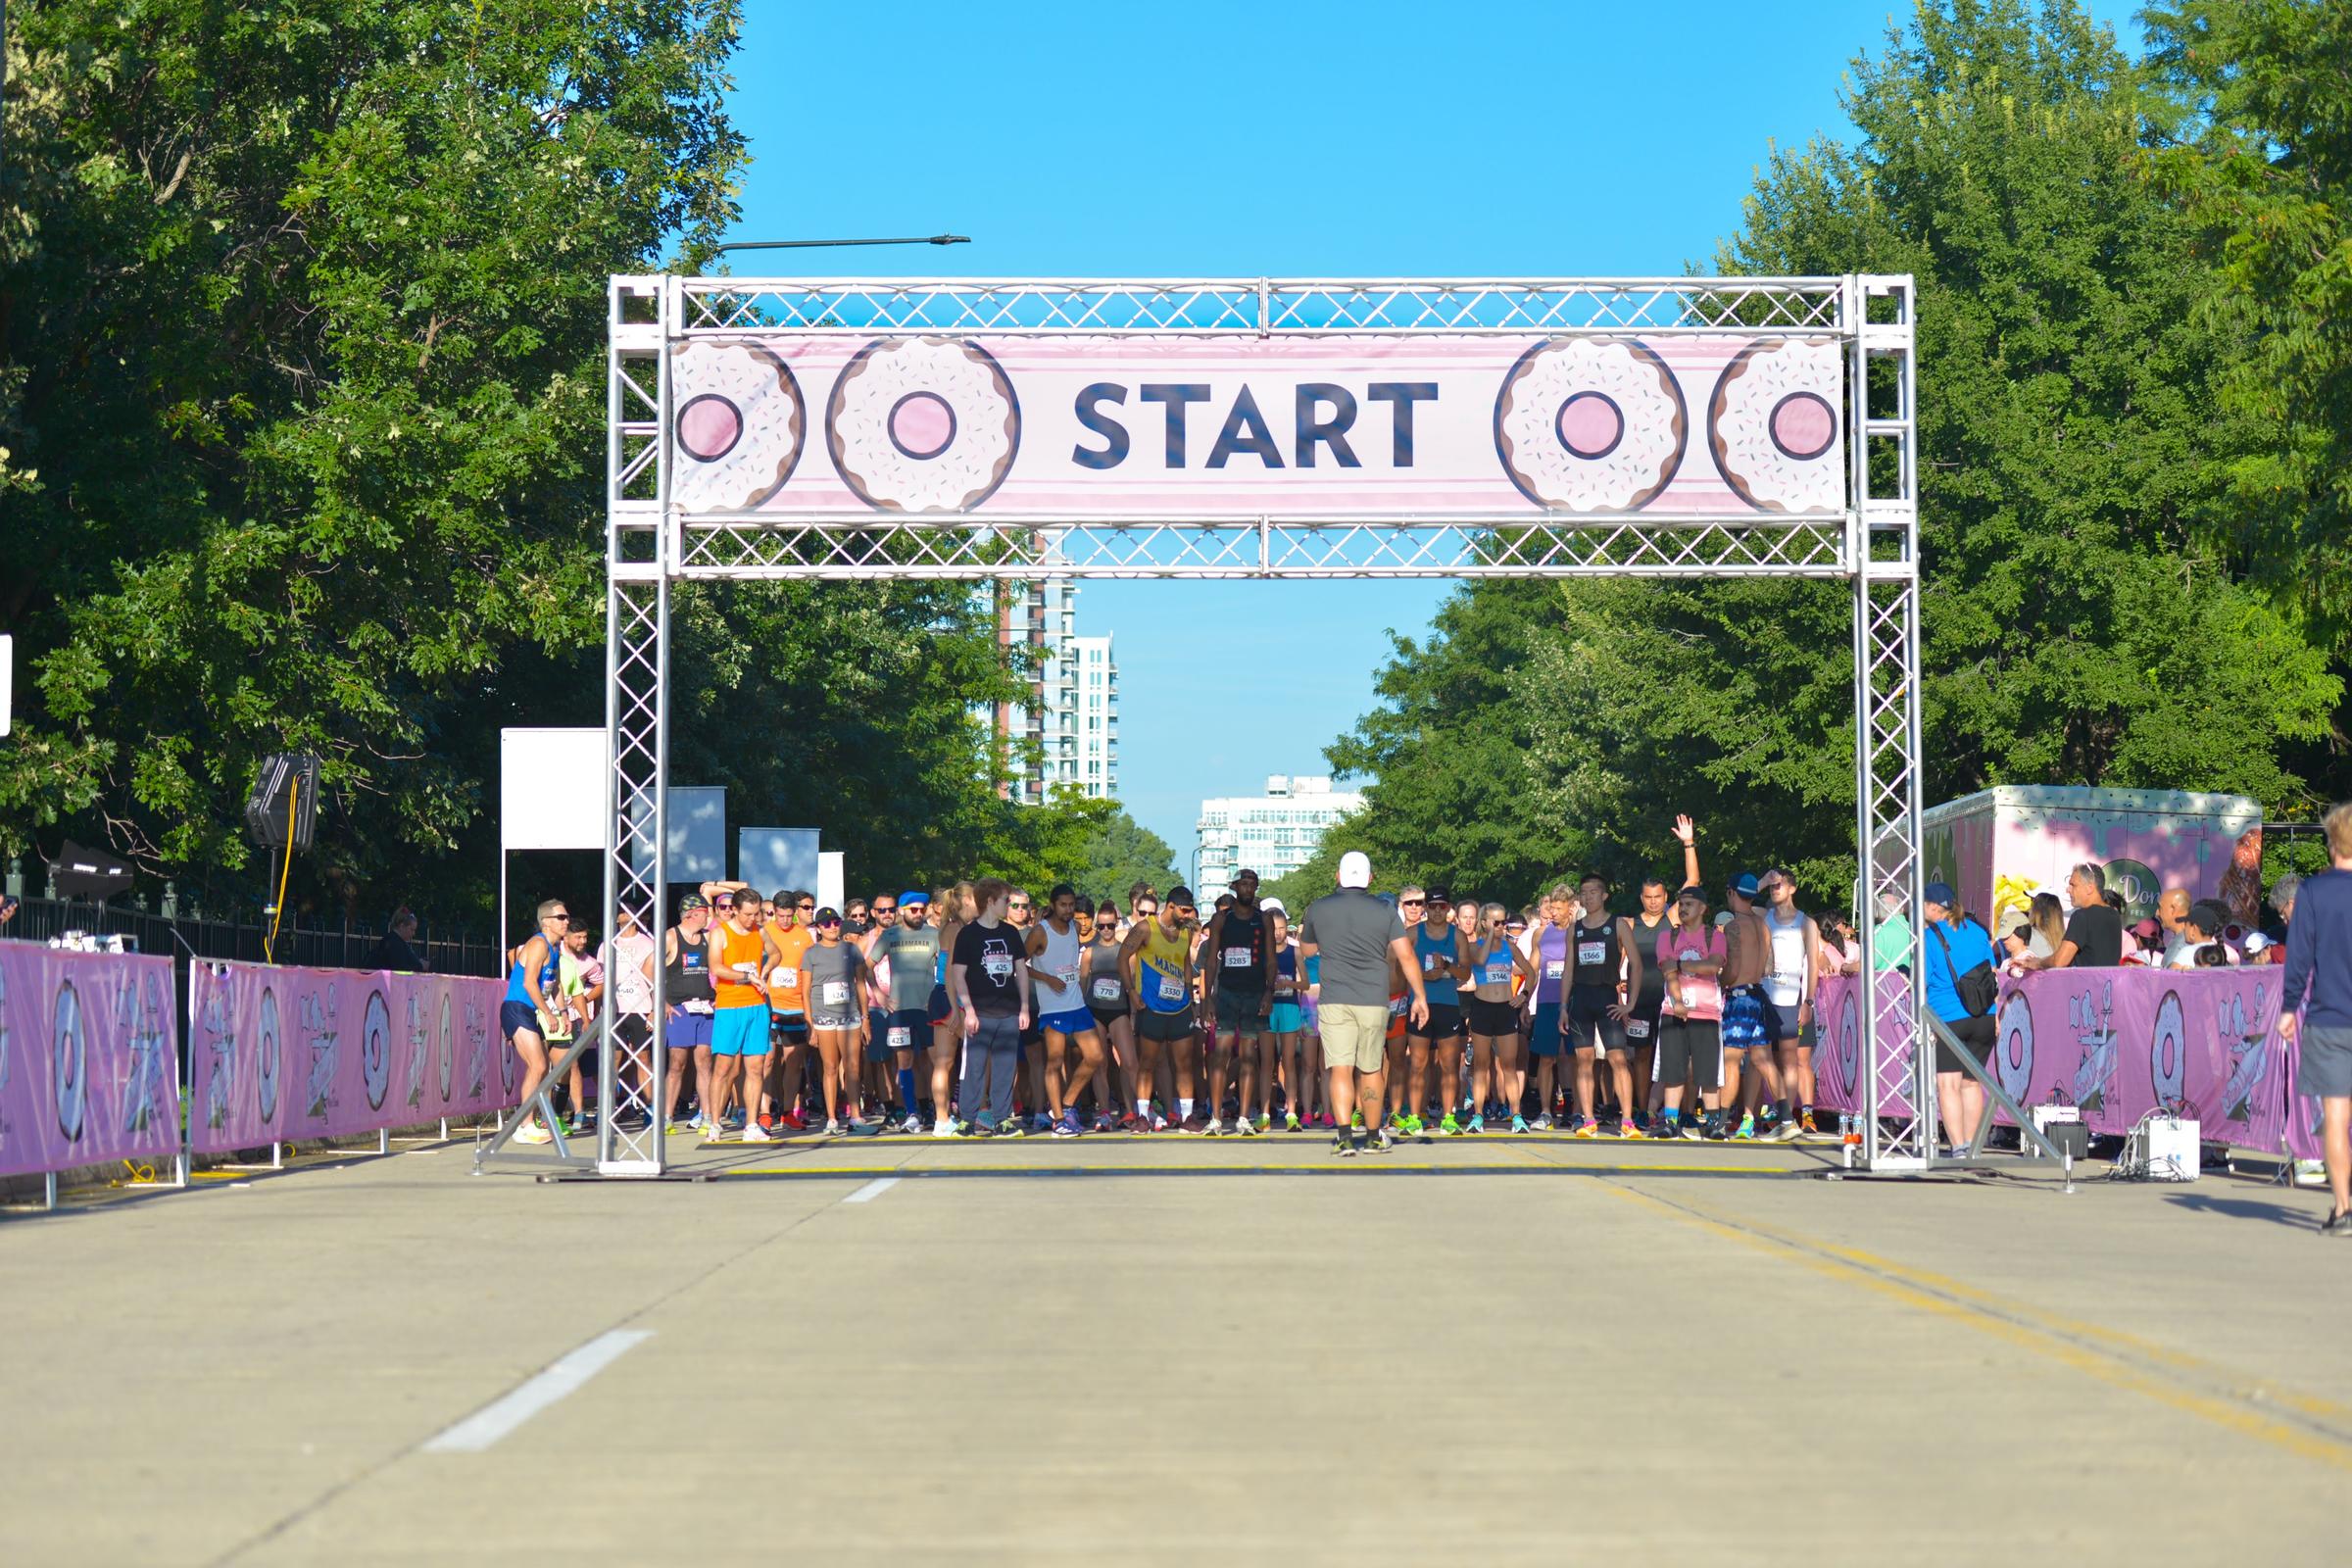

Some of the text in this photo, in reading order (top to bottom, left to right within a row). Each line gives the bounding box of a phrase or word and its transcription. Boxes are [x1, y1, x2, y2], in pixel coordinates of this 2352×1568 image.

[1070, 382, 1439, 469] START
[1584, 952, 1600, 960] 1366
[1101, 987, 1114, 997] 778
[1163, 987, 1181, 997] 3330
